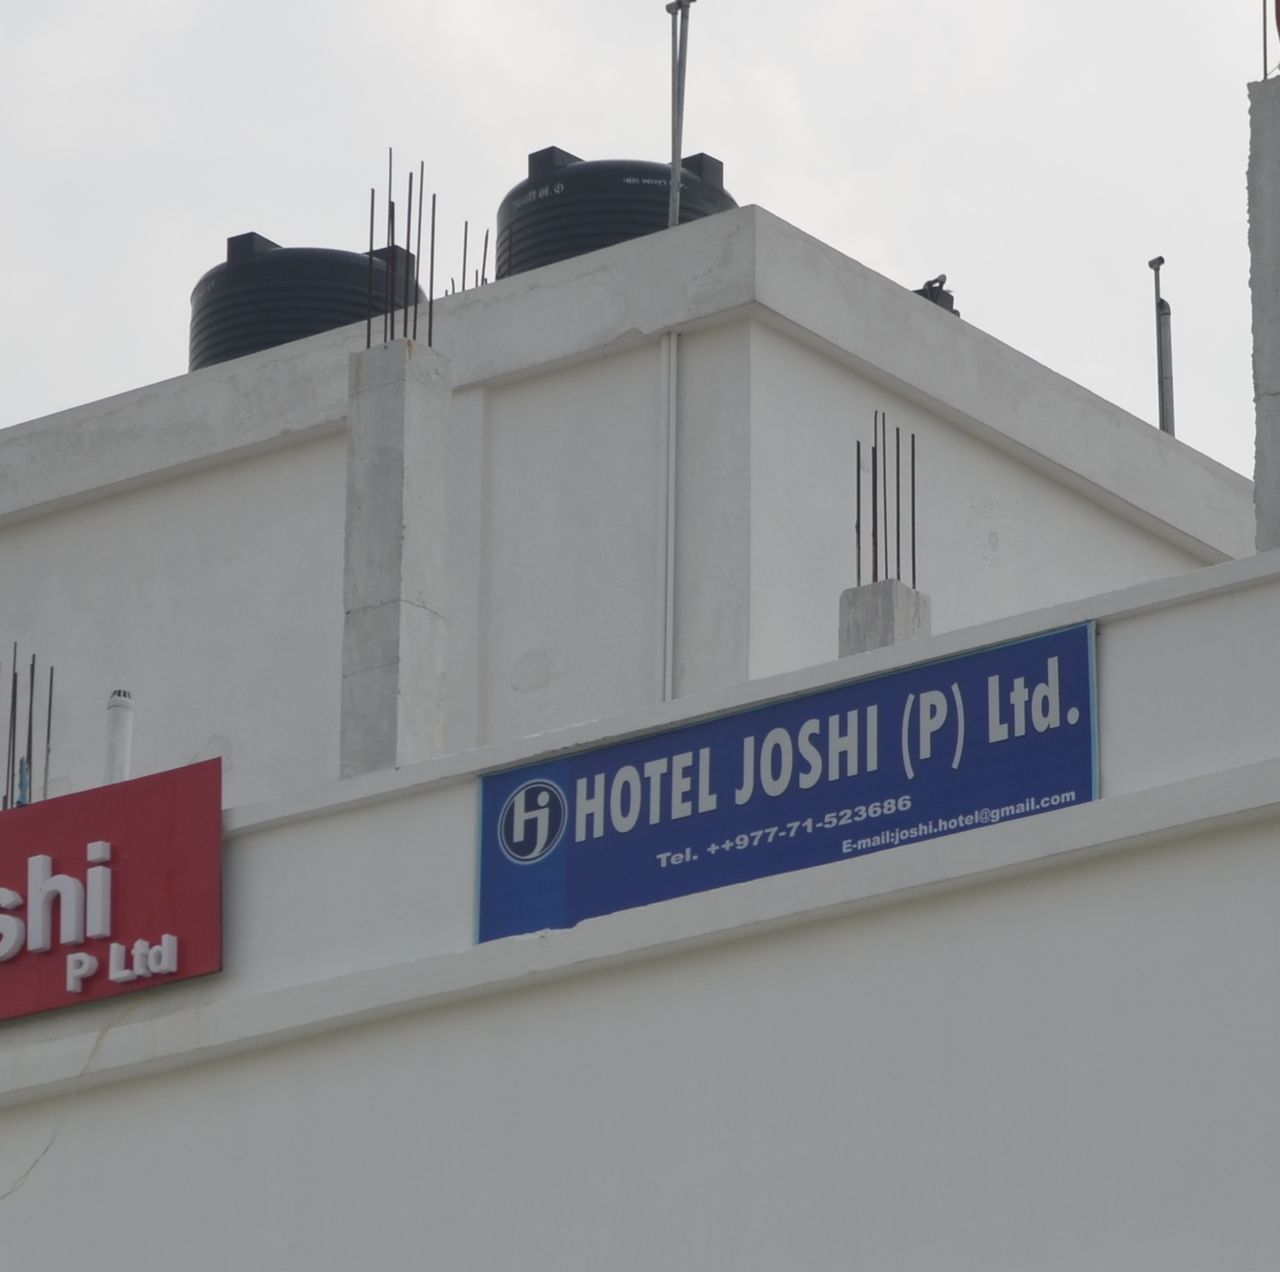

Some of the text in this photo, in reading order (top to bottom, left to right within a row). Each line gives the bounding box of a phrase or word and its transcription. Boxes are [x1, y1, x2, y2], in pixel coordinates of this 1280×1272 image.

[574, 655, 1080, 843] HOTEL JOSHI (P) Ltd.
[655, 795, 912, 868] Tel. ++977-71-523686
[66, 933, 179, 993] P Ltd
